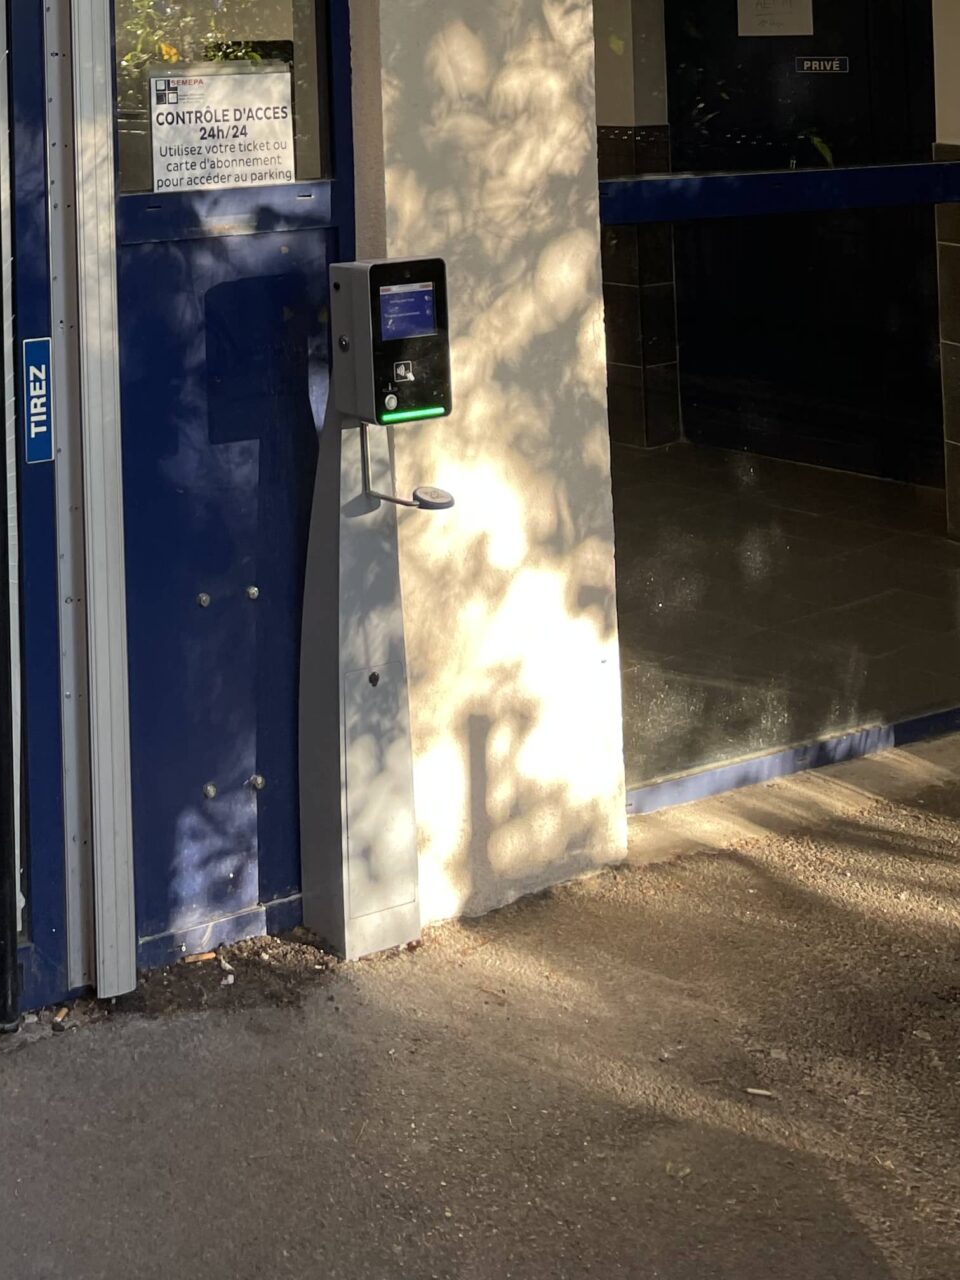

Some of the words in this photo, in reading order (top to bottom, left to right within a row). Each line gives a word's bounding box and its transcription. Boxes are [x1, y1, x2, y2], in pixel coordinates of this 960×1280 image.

[803, 57, 840, 70] PRIVÉ
[171, 78, 204, 86] SEMEPA
[156, 106, 229, 126] CONTRÔLE
[233, 106, 288, 122] D'ACCES
[199, 125, 248, 140] 24h/24
[159, 143, 203, 157] Utilisez
[205, 143, 238, 155] votre
[239, 141, 270, 152] ticket
[272, 141, 287, 150] ou
[166, 160, 197, 172] carte
[199, 155, 282, 170] d'abonnement
[156, 177, 184, 190] pour
[186, 172, 231, 186] accéder
[233, 173, 247, 182] au
[250, 169, 292, 183] parking
[29, 363, 47, 439] TIREZ
